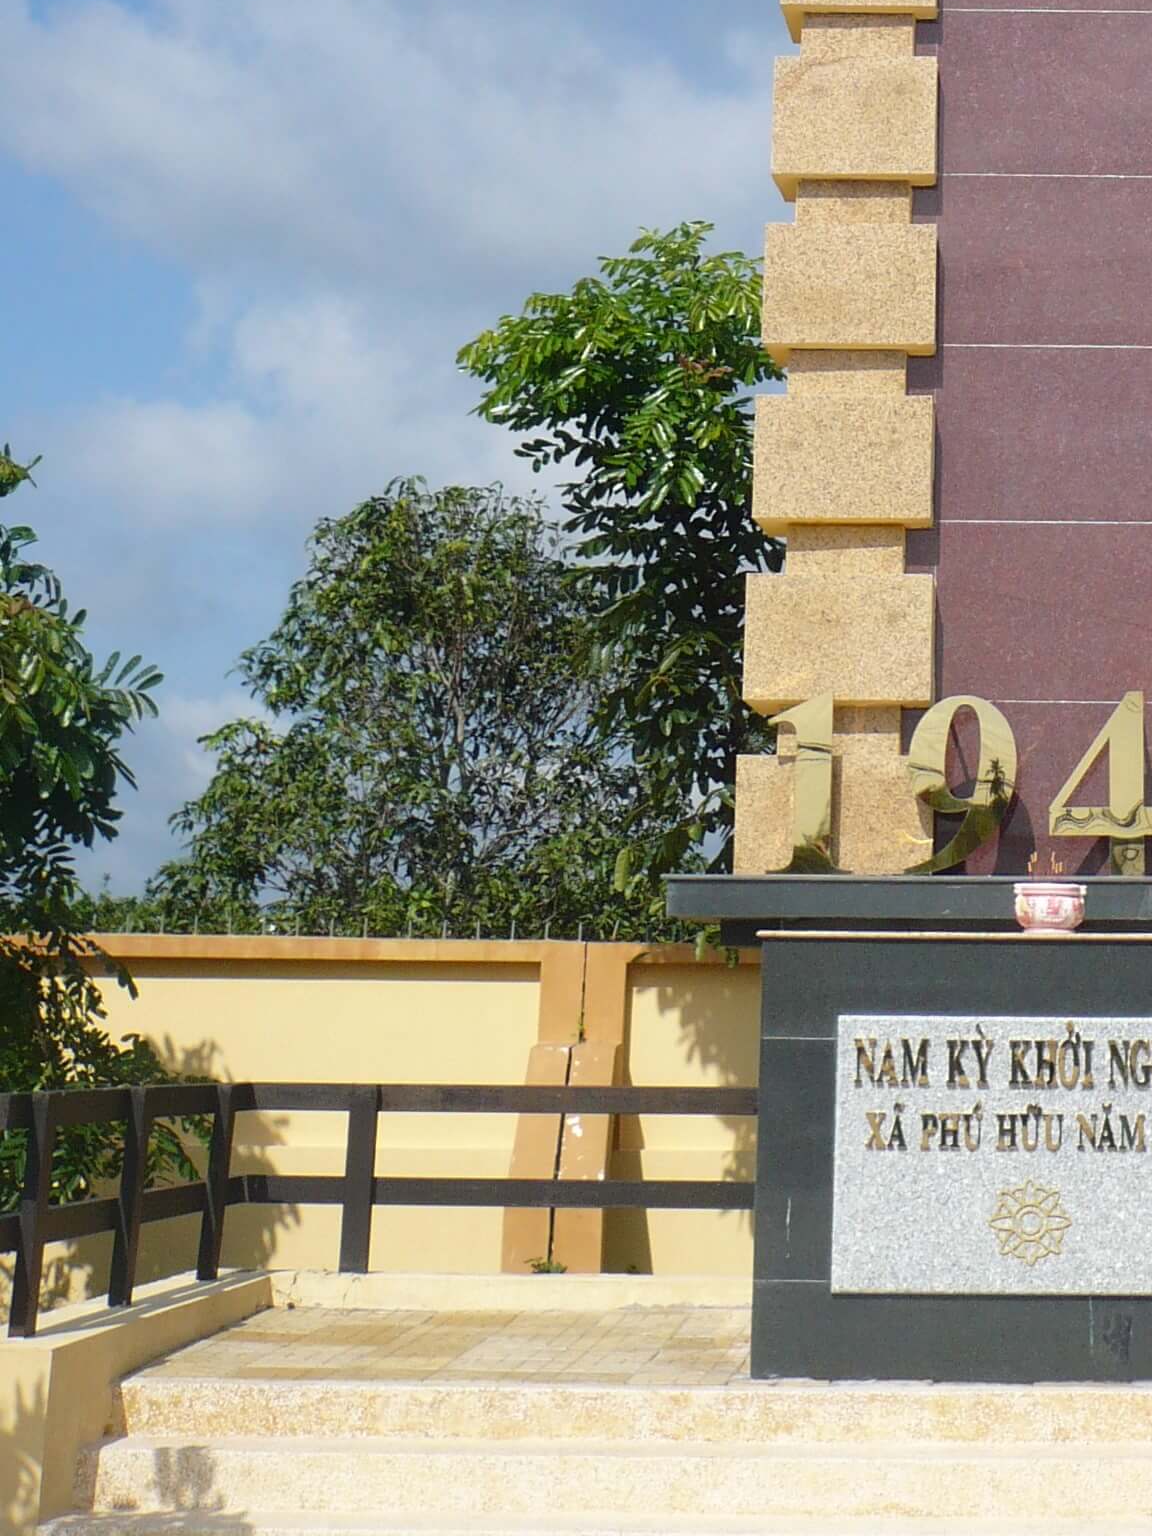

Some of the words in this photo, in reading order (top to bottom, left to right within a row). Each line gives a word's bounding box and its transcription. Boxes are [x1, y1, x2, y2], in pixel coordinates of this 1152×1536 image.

[853, 1036, 930, 1089] NAM
[946, 1023, 994, 1089] KỲ
[1008, 1021, 1094, 1090] KHỞI
[920, 1101, 983, 1152] PHÚ
[995, 1103, 1064, 1152] HỮU
[1075, 1103, 1146, 1152] NĂM
